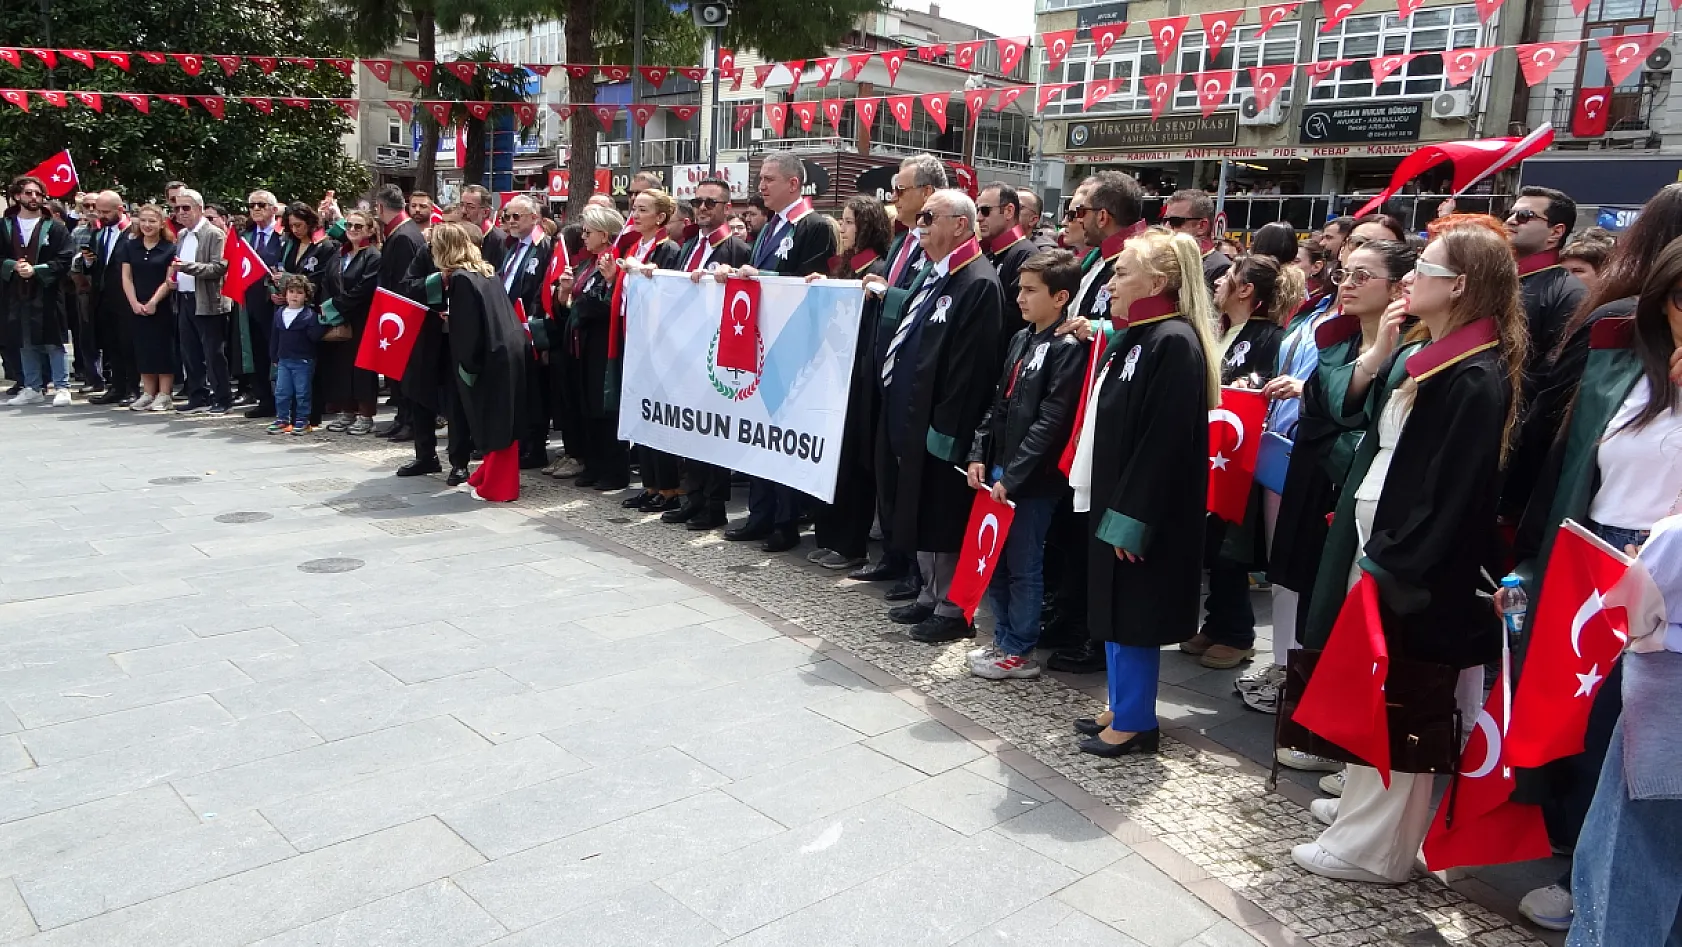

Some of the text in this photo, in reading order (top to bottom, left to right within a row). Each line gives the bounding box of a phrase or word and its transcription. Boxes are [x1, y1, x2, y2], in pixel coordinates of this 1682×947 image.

[1332, 109, 1360, 118] ARSLAN
[1092, 123, 1121, 137] TÜRK
[1125, 122, 1161, 134] METAL
[1122, 134, 1157, 143] SAMSUN
[1088, 154, 1115, 162] KEBAP
[1126, 152, 1171, 161] KAHVALTI
[1184, 148, 1213, 159] ANIT
[1216, 147, 1258, 157] TERME
[1312, 147, 1350, 156] KEBAP
[641, 398, 825, 464] SAMSUN BAROSU
